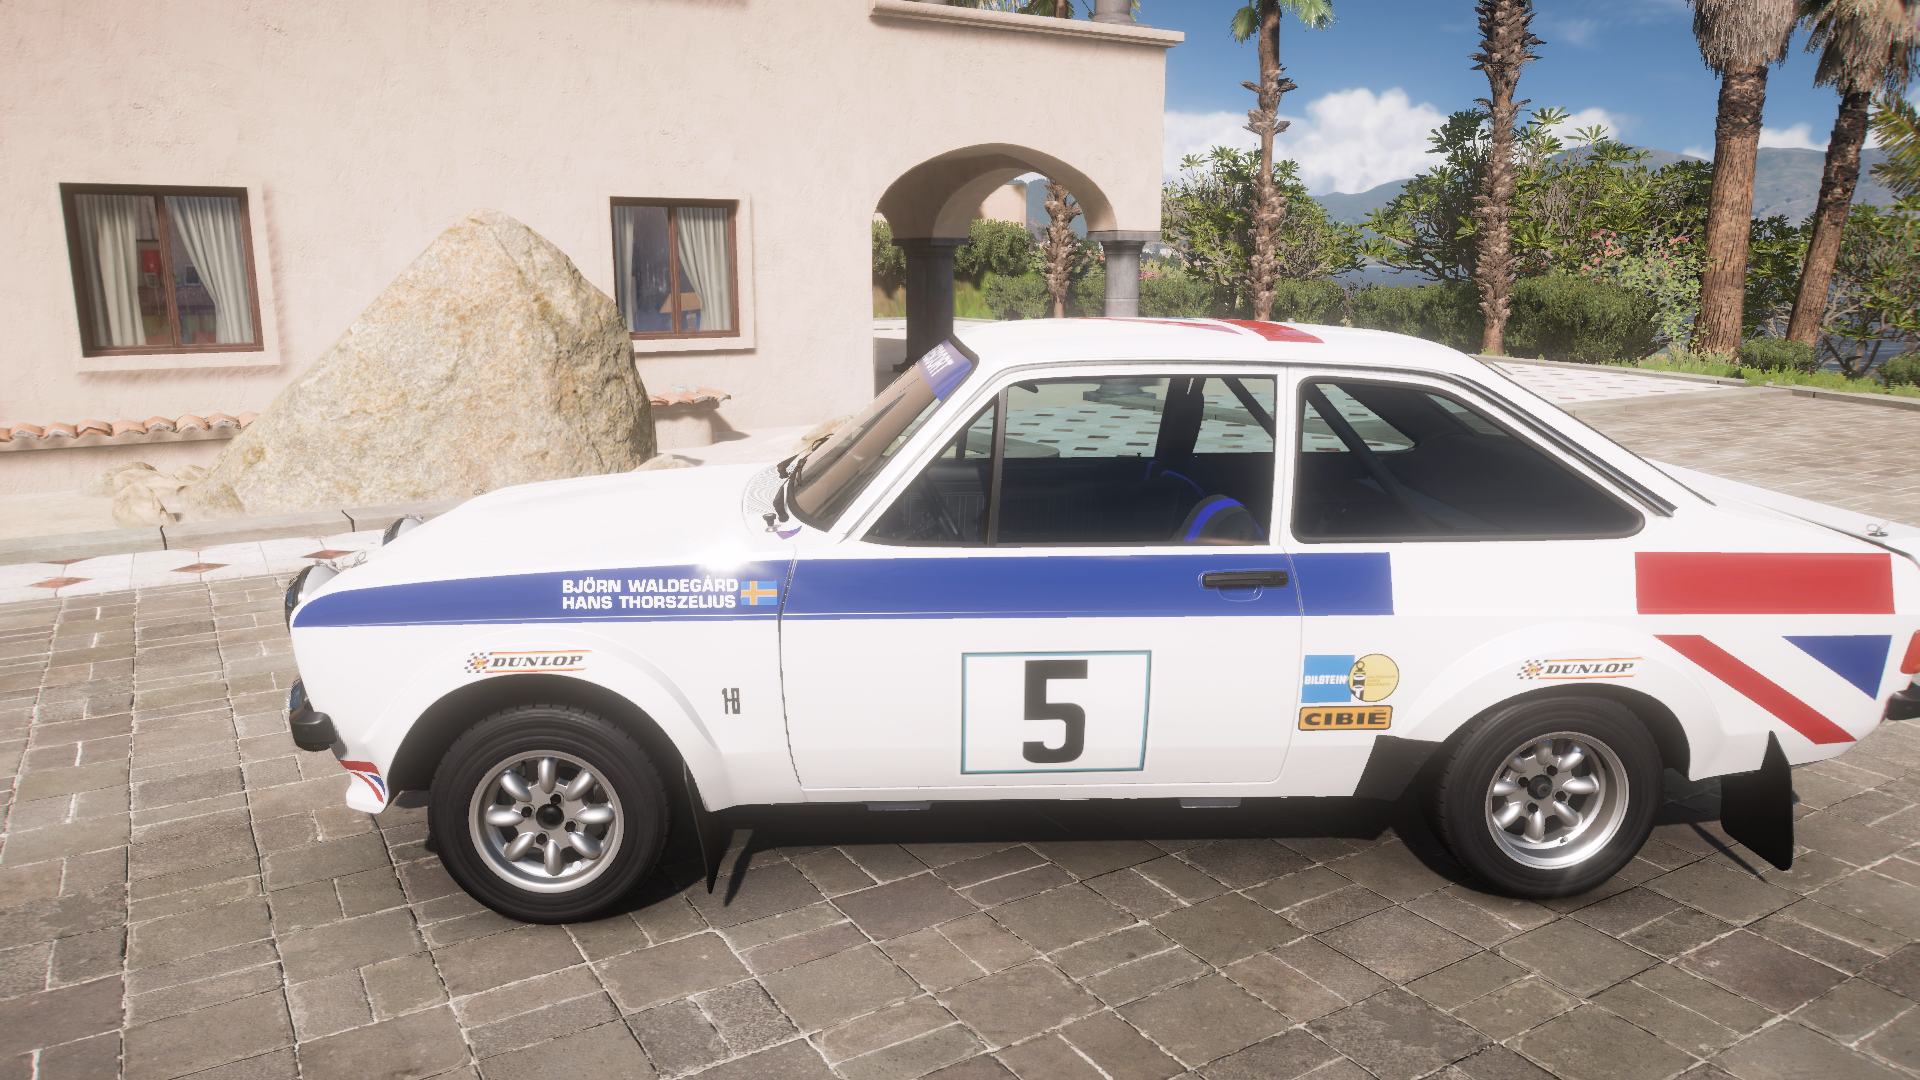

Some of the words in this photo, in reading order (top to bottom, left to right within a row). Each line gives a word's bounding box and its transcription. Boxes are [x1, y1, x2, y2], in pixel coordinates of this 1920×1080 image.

[562, 577, 622, 594] BJÖRN
[628, 575, 739, 593] WALDEGÅRD
[562, 596, 613, 610] HANS
[619, 595, 736, 609] THORSZELIUS
[491, 655, 583, 668] DUNLOP
[1544, 662, 1635, 675] DUNLOP
[1022, 659, 1088, 763] 5
